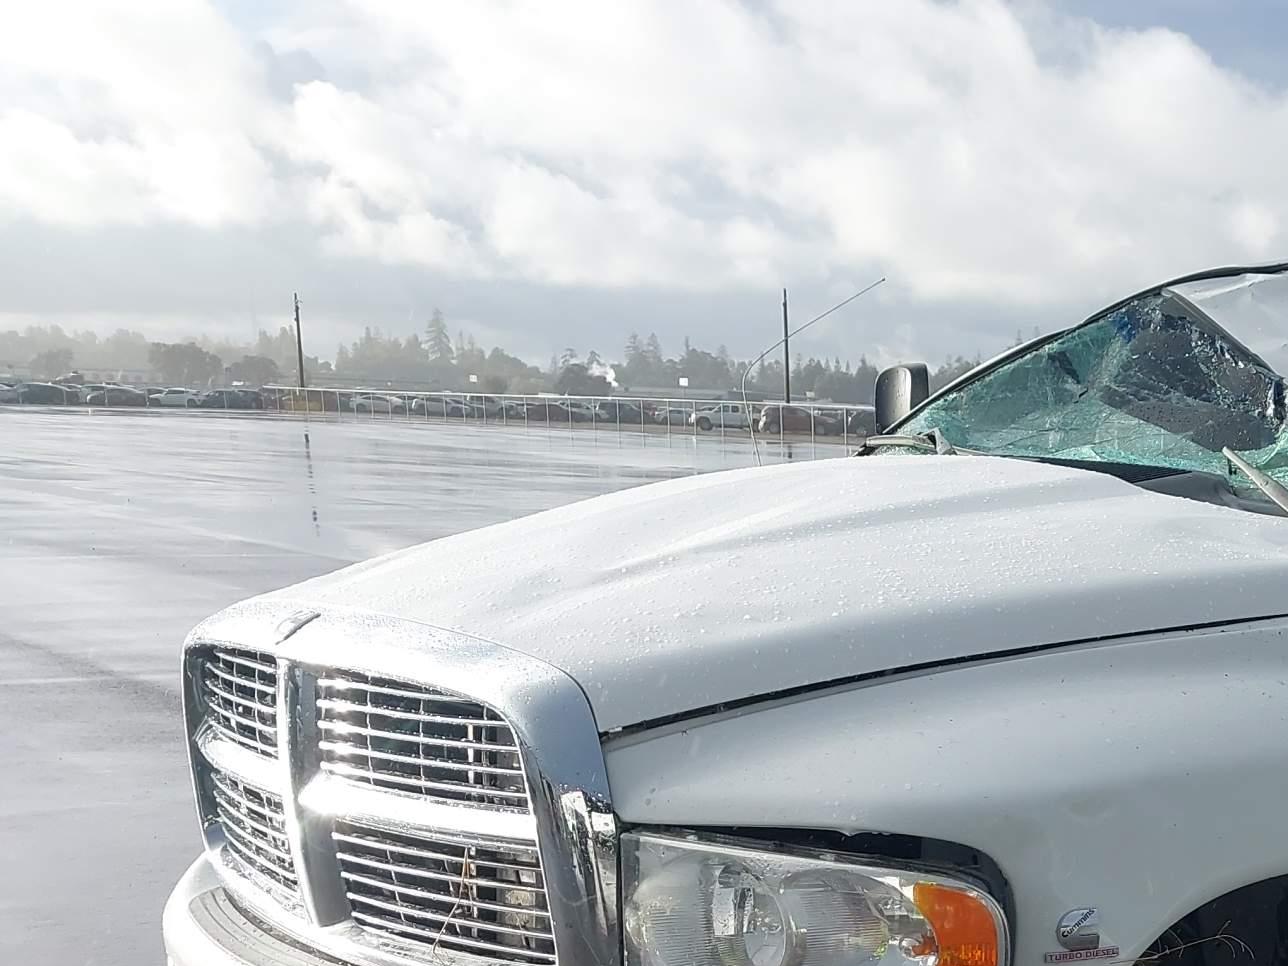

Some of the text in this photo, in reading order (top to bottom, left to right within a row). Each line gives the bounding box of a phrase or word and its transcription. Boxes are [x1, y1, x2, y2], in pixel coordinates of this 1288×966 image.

[1061, 908, 1095, 938] Cummins
[1047, 948, 1117, 961] TURBO DIESEL
